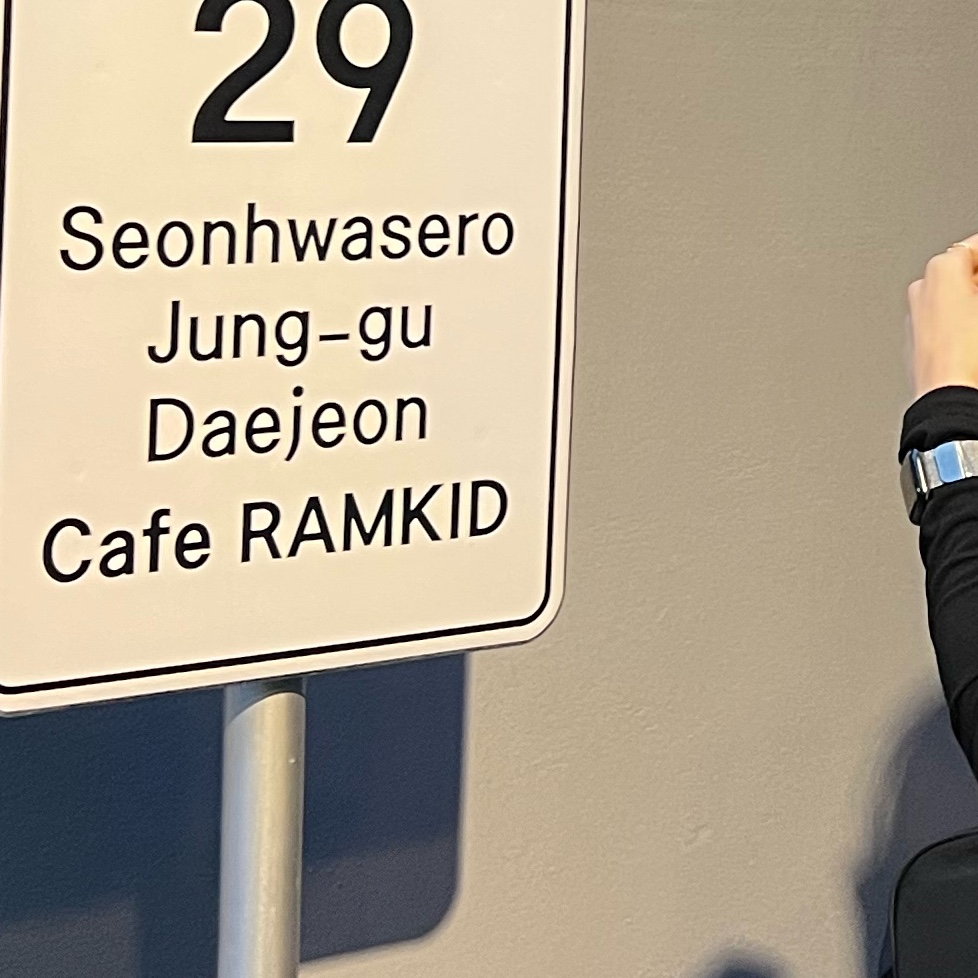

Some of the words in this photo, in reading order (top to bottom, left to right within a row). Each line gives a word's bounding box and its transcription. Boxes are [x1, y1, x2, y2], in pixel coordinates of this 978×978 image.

[191, 0, 414, 143] 29
[59, 203, 515, 271] Seonhwasero
[147, 300, 432, 367] Jung-gu
[148, 386, 428, 463] Daejeon
[42, 509, 211, 583] Cafe
[241, 480, 509, 563] RAMKID
